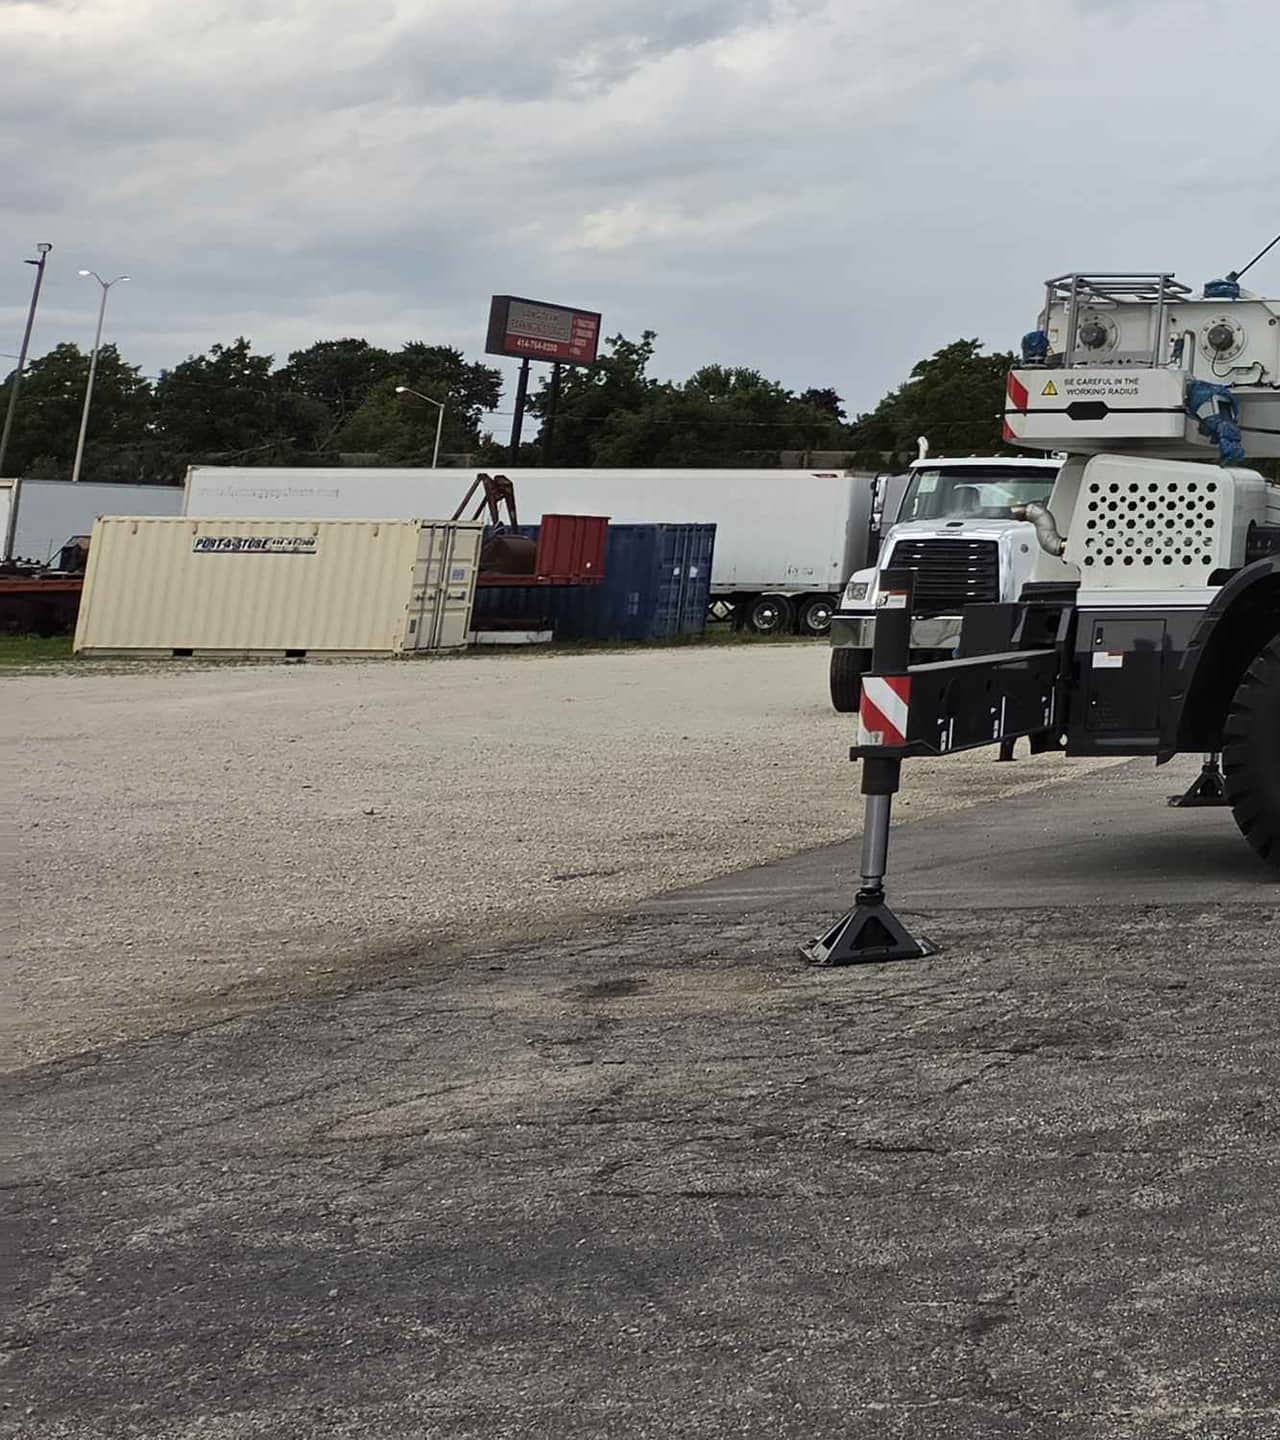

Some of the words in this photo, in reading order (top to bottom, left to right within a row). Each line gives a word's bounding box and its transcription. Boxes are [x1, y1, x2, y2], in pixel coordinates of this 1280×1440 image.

[1124, 377, 1139, 385] THE
[1066, 387, 1106, 396] WORKING
[1108, 387, 1139, 395] RADIUS
